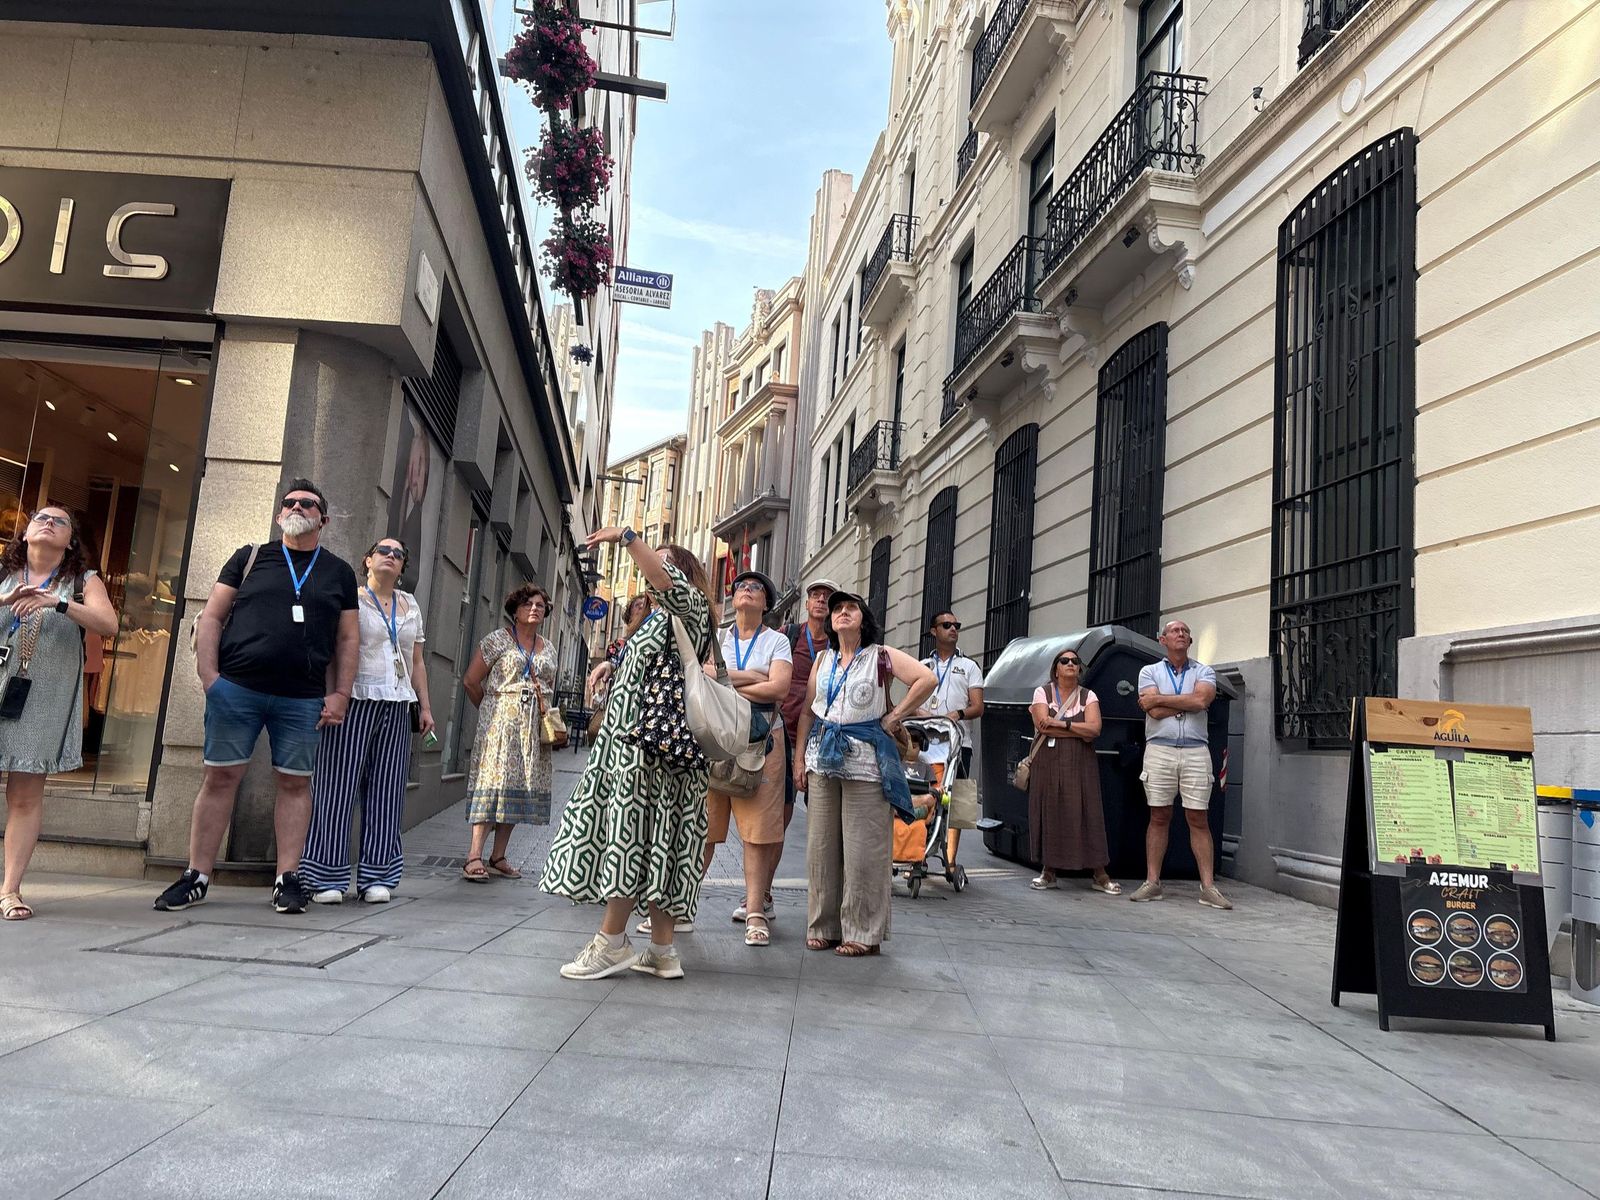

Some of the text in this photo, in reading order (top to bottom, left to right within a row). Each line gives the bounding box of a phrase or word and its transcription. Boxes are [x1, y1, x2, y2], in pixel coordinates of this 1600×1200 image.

[618, 270, 655, 285] Allianz
[615, 284, 670, 300] ASESORIA ALVAREZ
[1429, 872, 1488, 889] AZEMUR
[1441, 887, 1484, 900] CRAFT
[1446, 900, 1476, 910] BURGER
